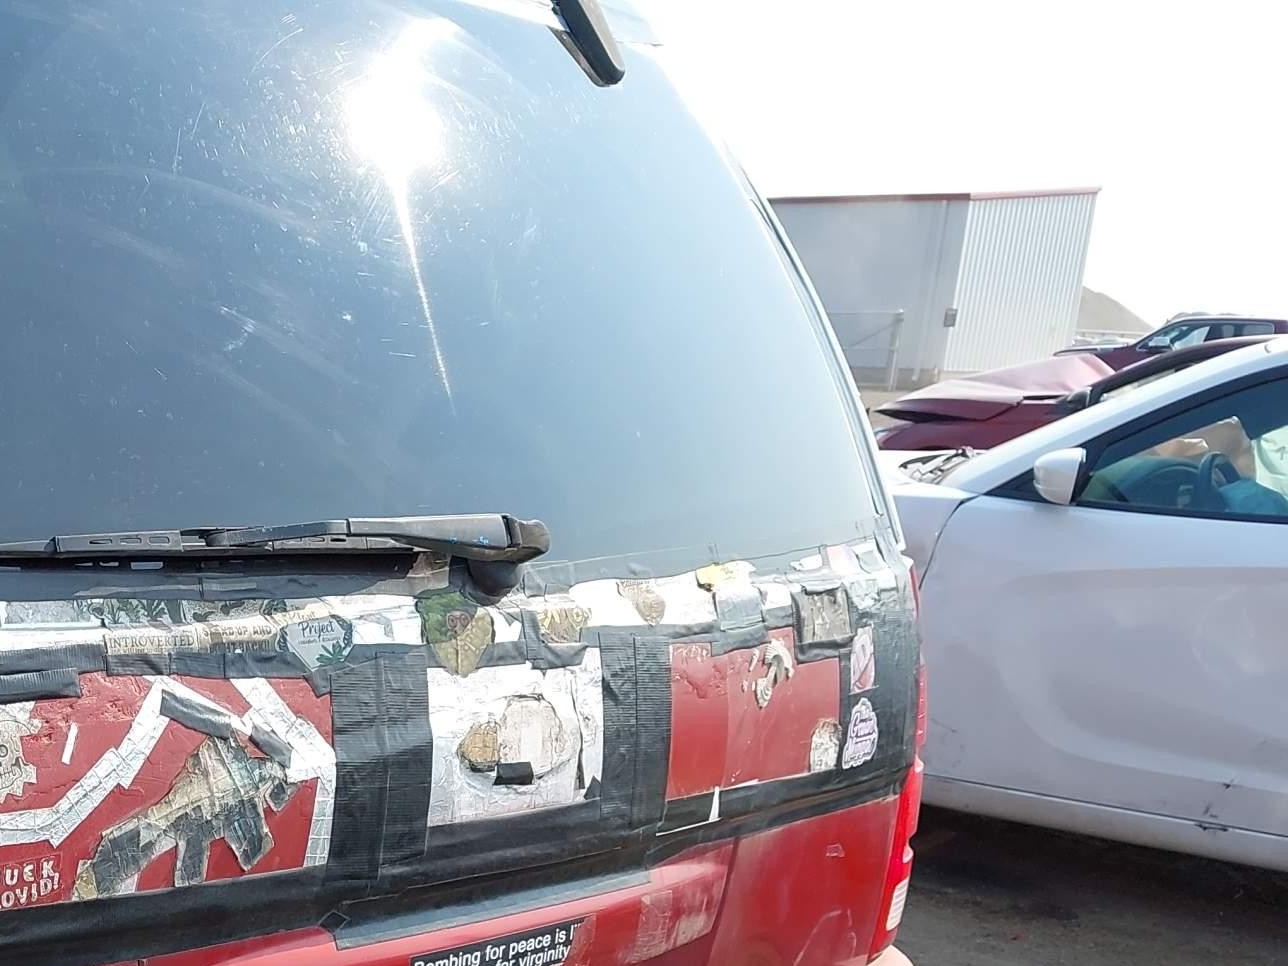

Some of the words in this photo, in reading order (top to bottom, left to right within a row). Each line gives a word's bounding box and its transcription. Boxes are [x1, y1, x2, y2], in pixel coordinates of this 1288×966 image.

[203, 626, 234, 637] SAND
[109, 634, 194, 648] INTROVERTED
[486, 945, 506, 962] for
[509, 934, 551, 958] peace
[555, 929, 567, 945] is
